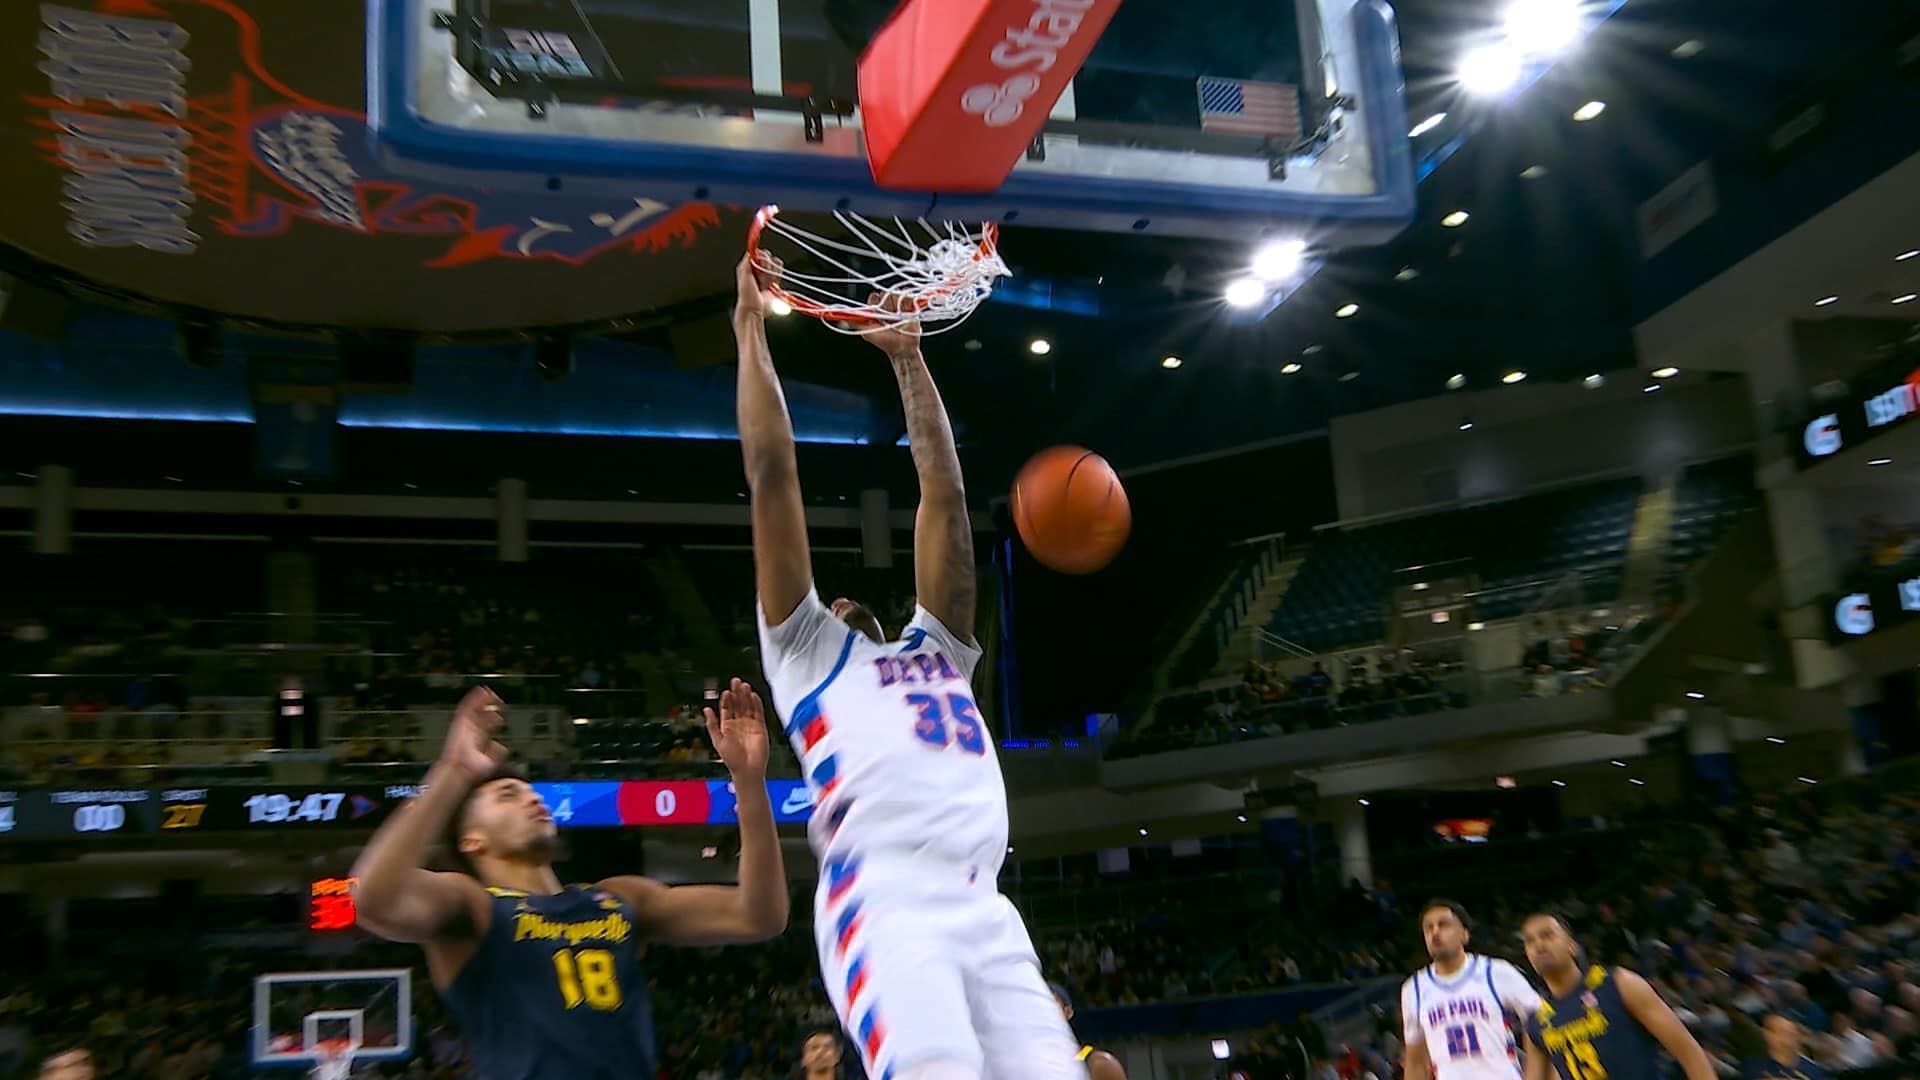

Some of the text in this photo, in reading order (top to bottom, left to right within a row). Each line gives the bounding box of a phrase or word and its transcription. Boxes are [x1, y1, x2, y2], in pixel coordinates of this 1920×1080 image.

[905, 692, 985, 757] 35
[243, 793, 346, 823] 19:47
[655, 789, 677, 817] 0
[552, 948, 624, 1010] 18
[1445, 1021, 1482, 1059] 21
